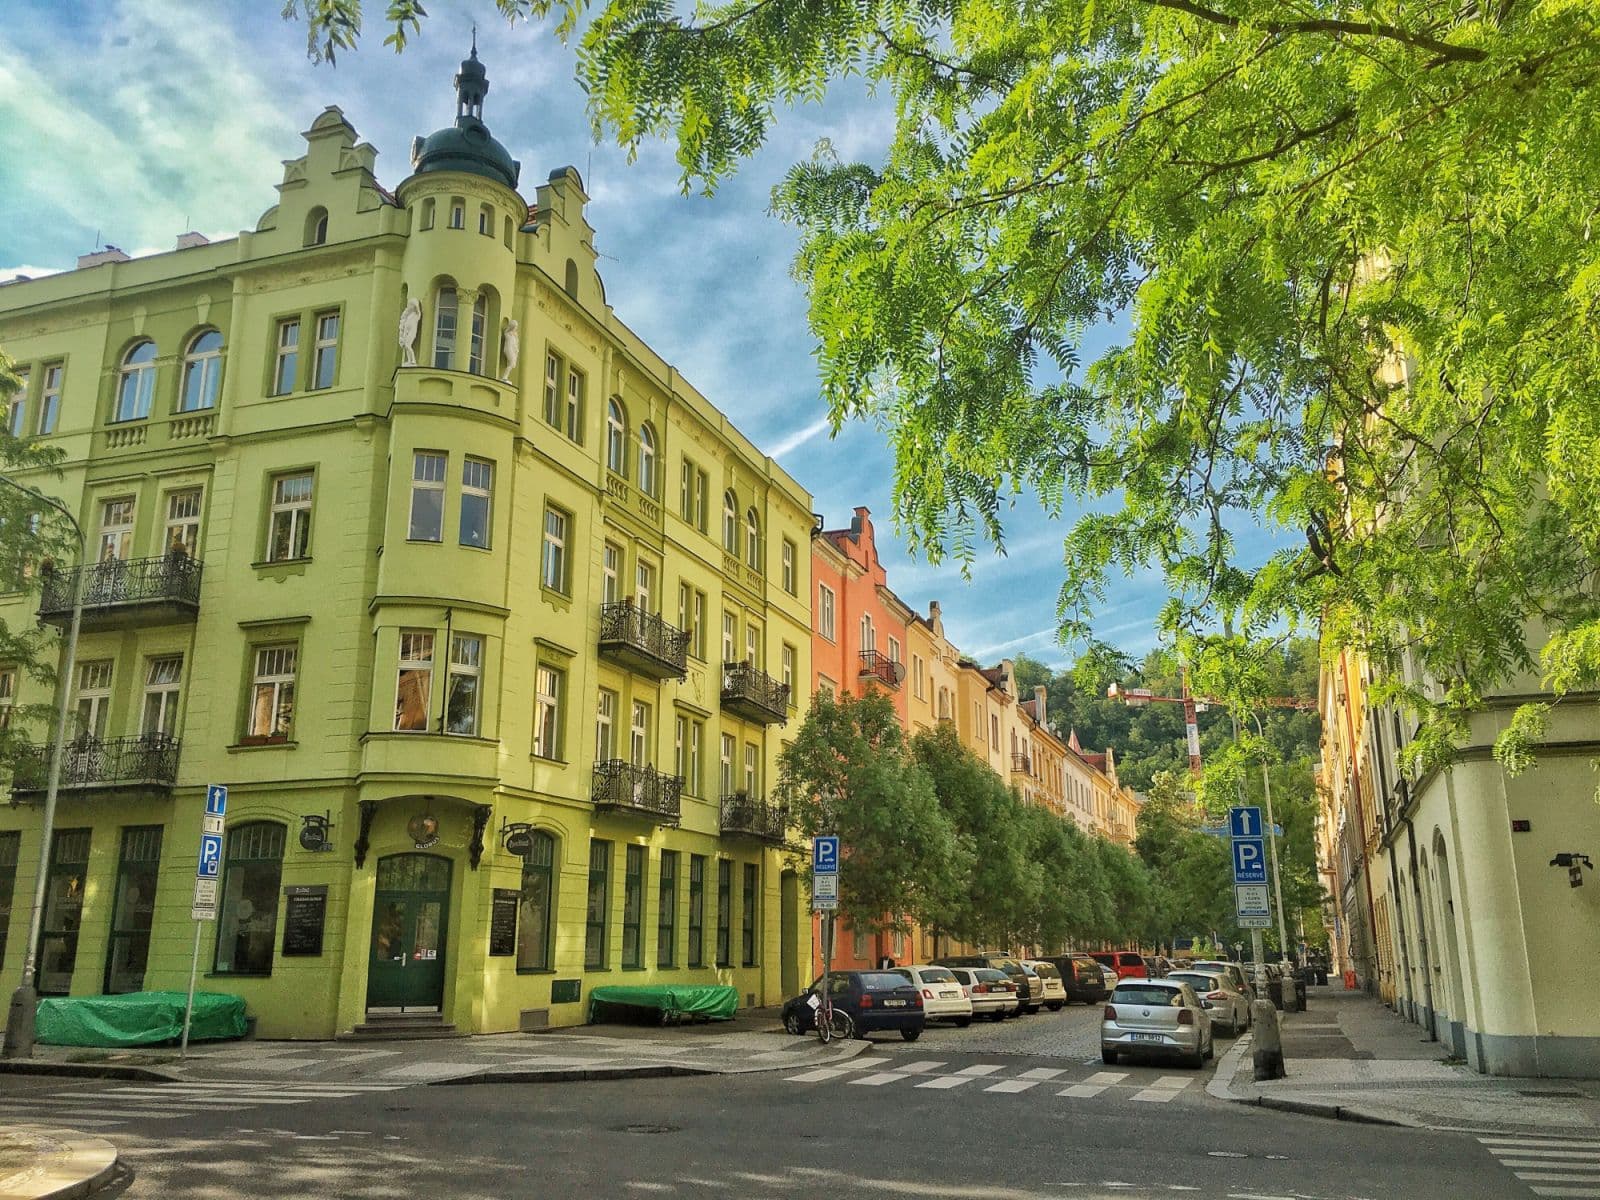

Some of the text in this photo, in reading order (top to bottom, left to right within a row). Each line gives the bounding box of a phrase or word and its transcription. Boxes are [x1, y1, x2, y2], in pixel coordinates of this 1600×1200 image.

[203, 840, 218, 863] P
[415, 837, 440, 849] GLOBUS
[819, 841, 833, 863] P
[1238, 844, 1258, 870] P
